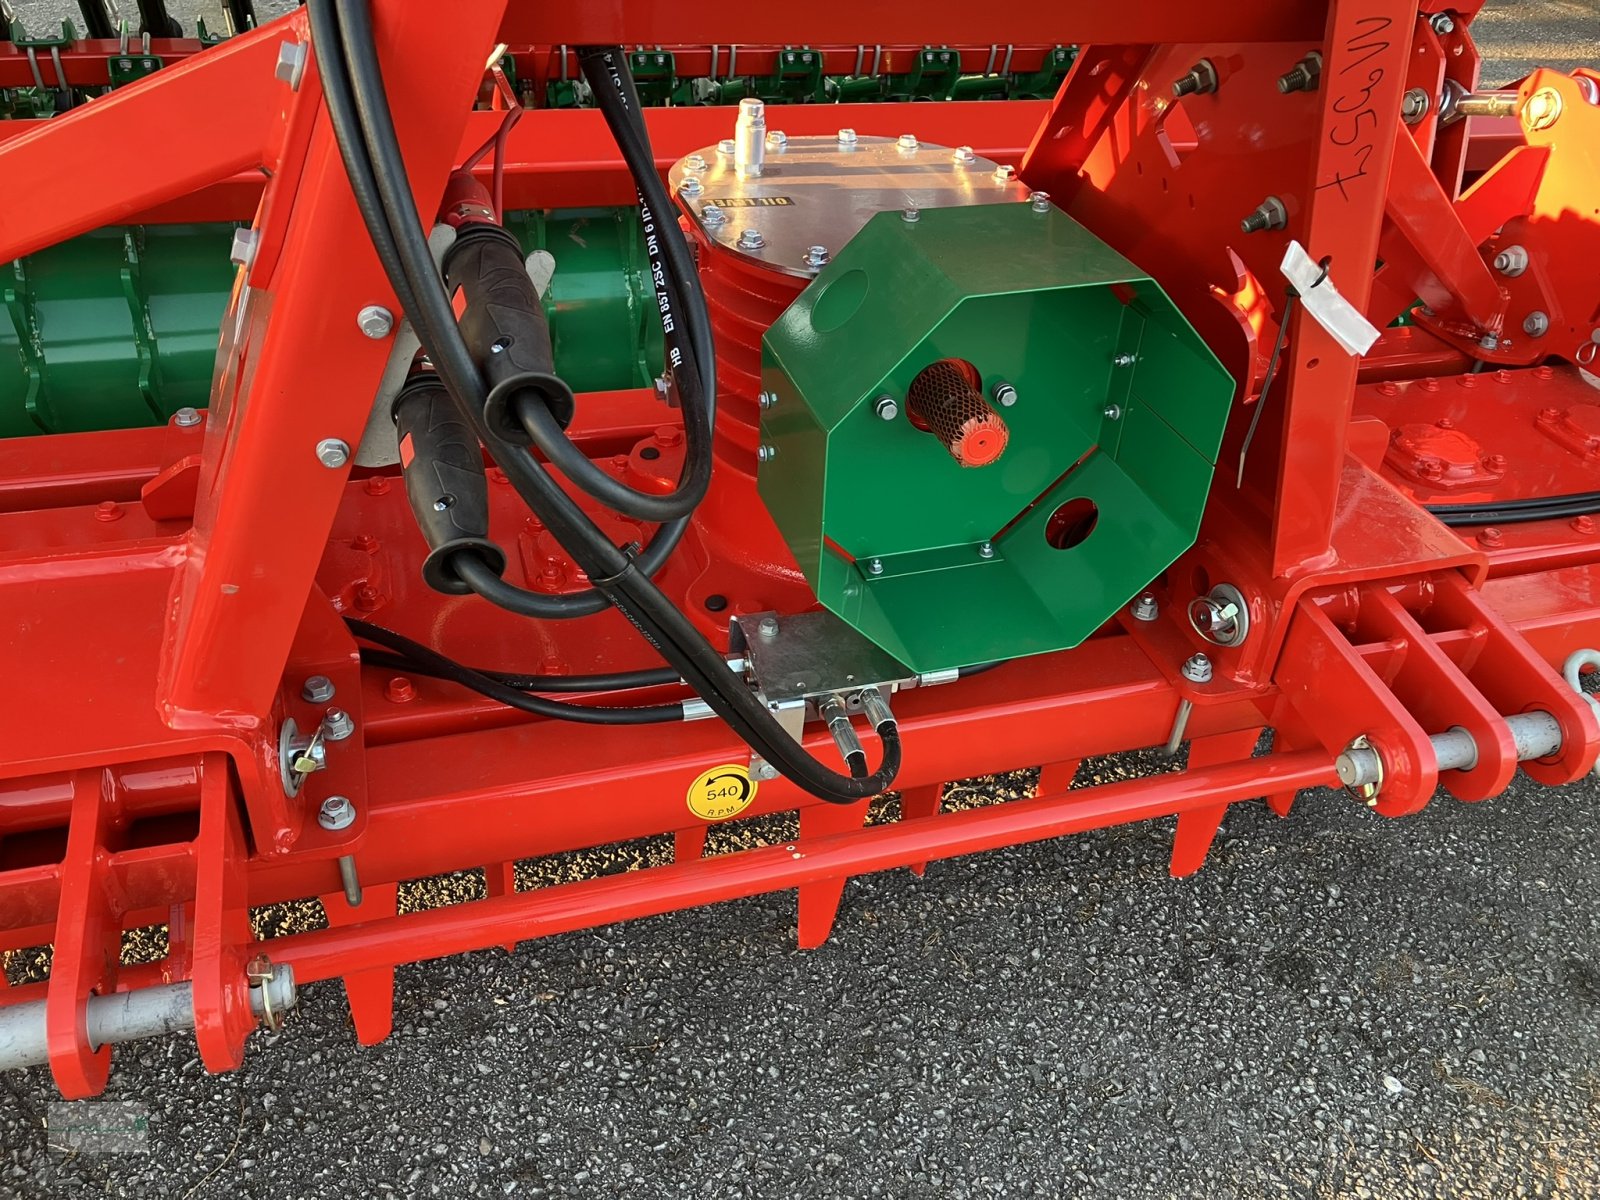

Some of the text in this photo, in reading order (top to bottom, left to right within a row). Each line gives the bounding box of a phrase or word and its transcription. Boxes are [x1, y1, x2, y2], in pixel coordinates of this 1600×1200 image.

[759, 197, 788, 206] OIL
[644, 223, 655, 234] 6
[646, 234, 659, 257] DN
[651, 260, 666, 290] 2SC
[657, 290, 671, 314] 857
[662, 314, 675, 335] EN
[669, 346, 683, 369] HB
[706, 785, 738, 801] 540
